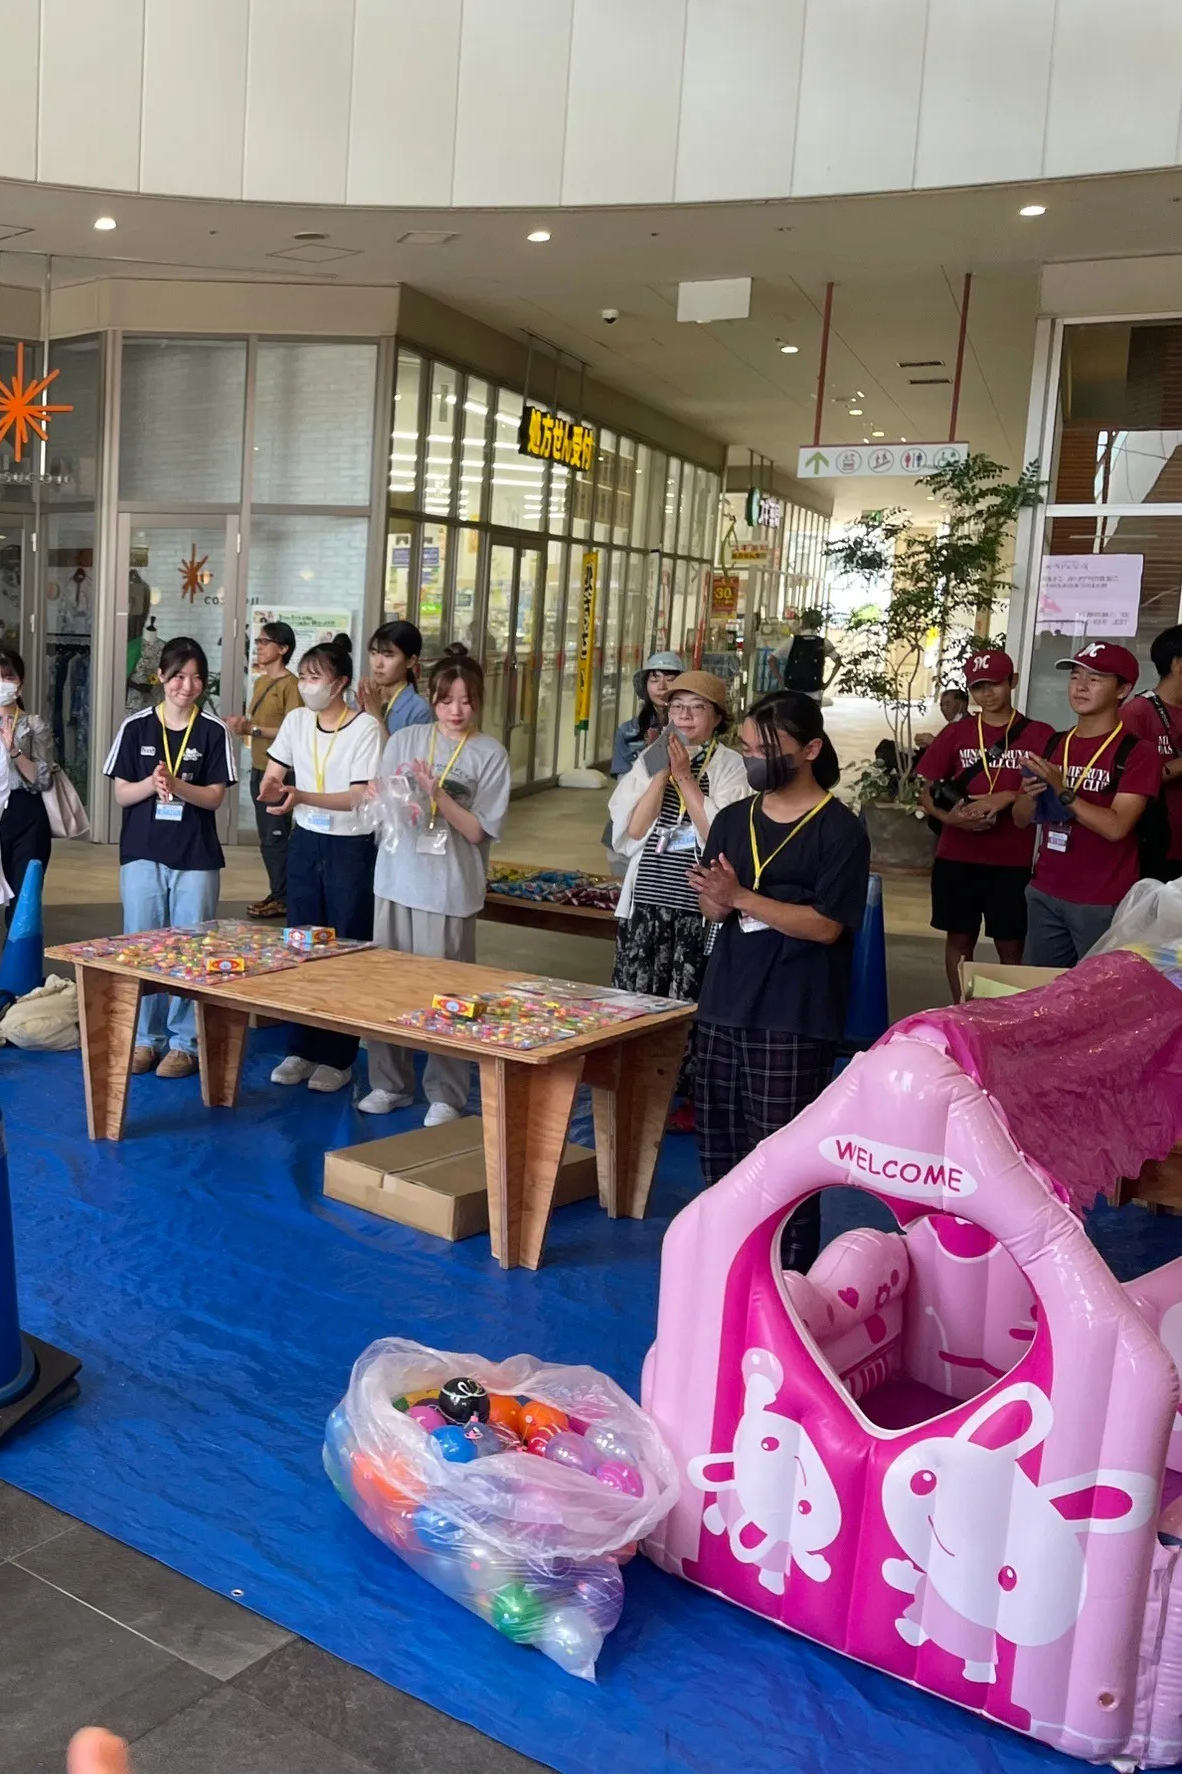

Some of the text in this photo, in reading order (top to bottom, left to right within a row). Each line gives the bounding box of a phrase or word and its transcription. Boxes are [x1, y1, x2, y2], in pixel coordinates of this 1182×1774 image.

[528, 407, 594, 470] 処方せん受付
[836, 1140, 963, 1192] WELCOME
